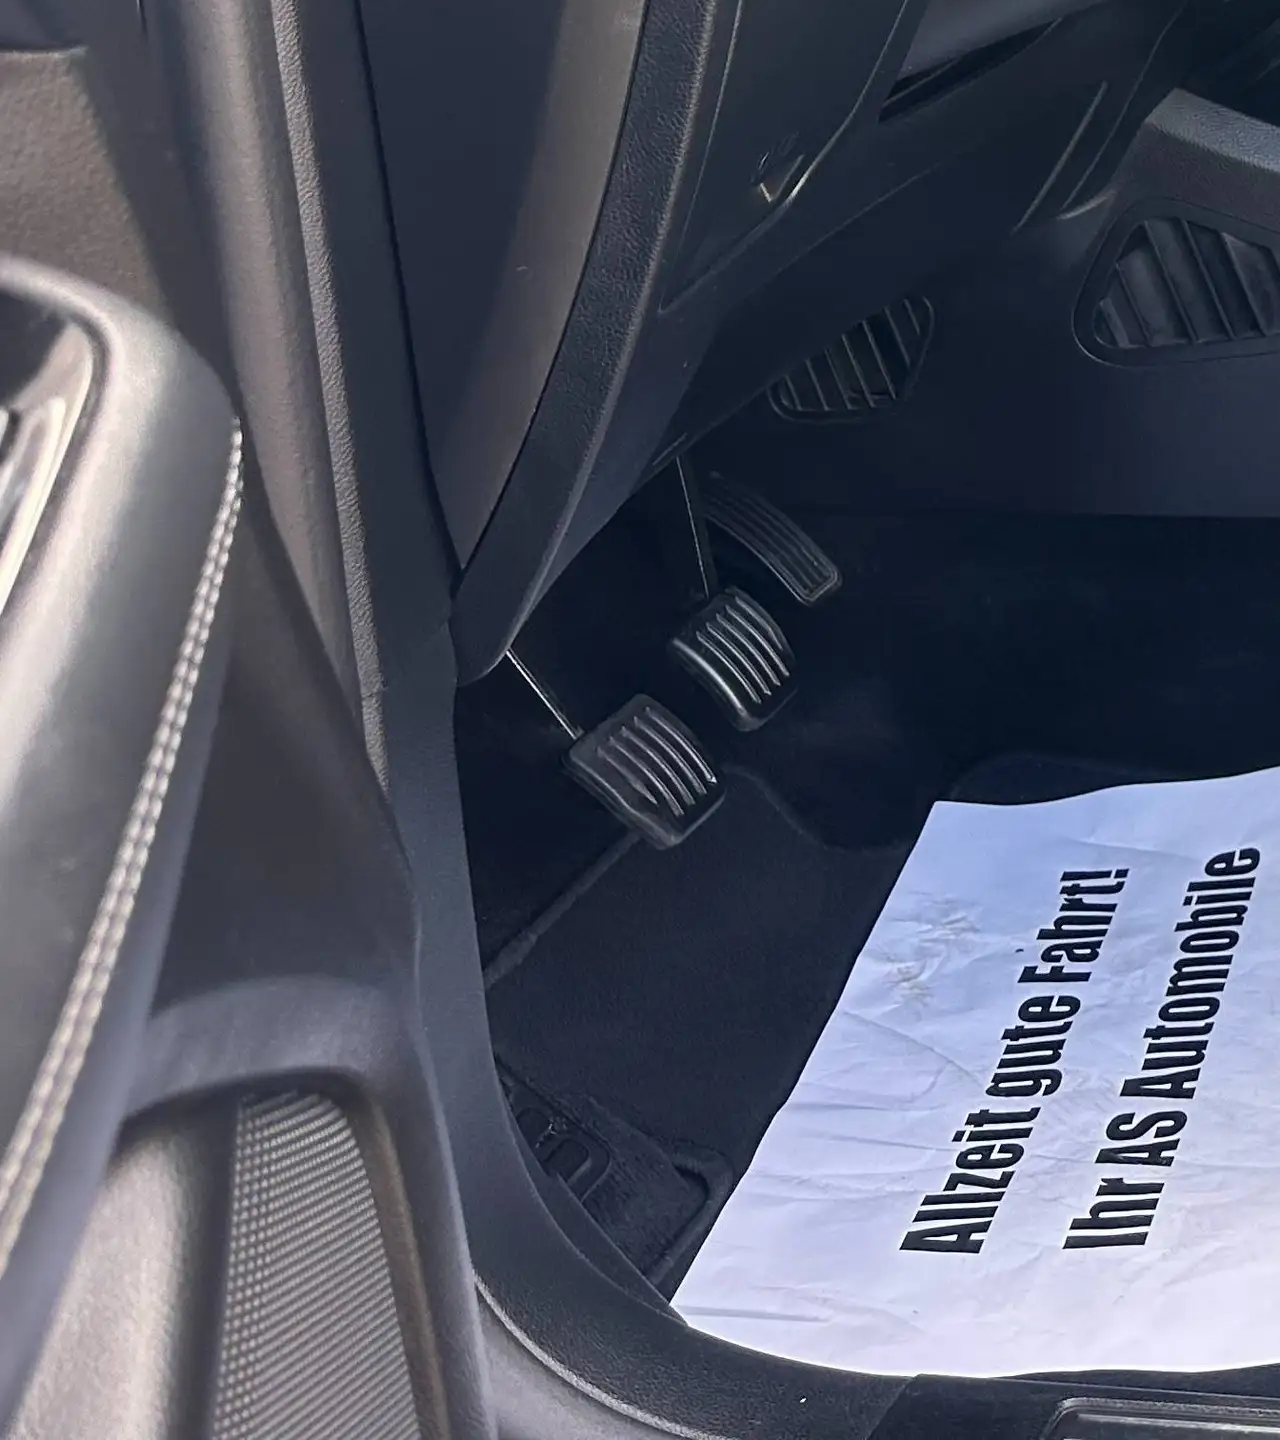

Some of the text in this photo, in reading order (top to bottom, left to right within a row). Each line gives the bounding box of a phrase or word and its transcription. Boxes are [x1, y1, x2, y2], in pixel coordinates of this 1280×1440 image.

[900, 866, 1130, 1255] Allzeit gute Fahrt!
[1064, 845, 1263, 1251] Ihr AS Automobile
